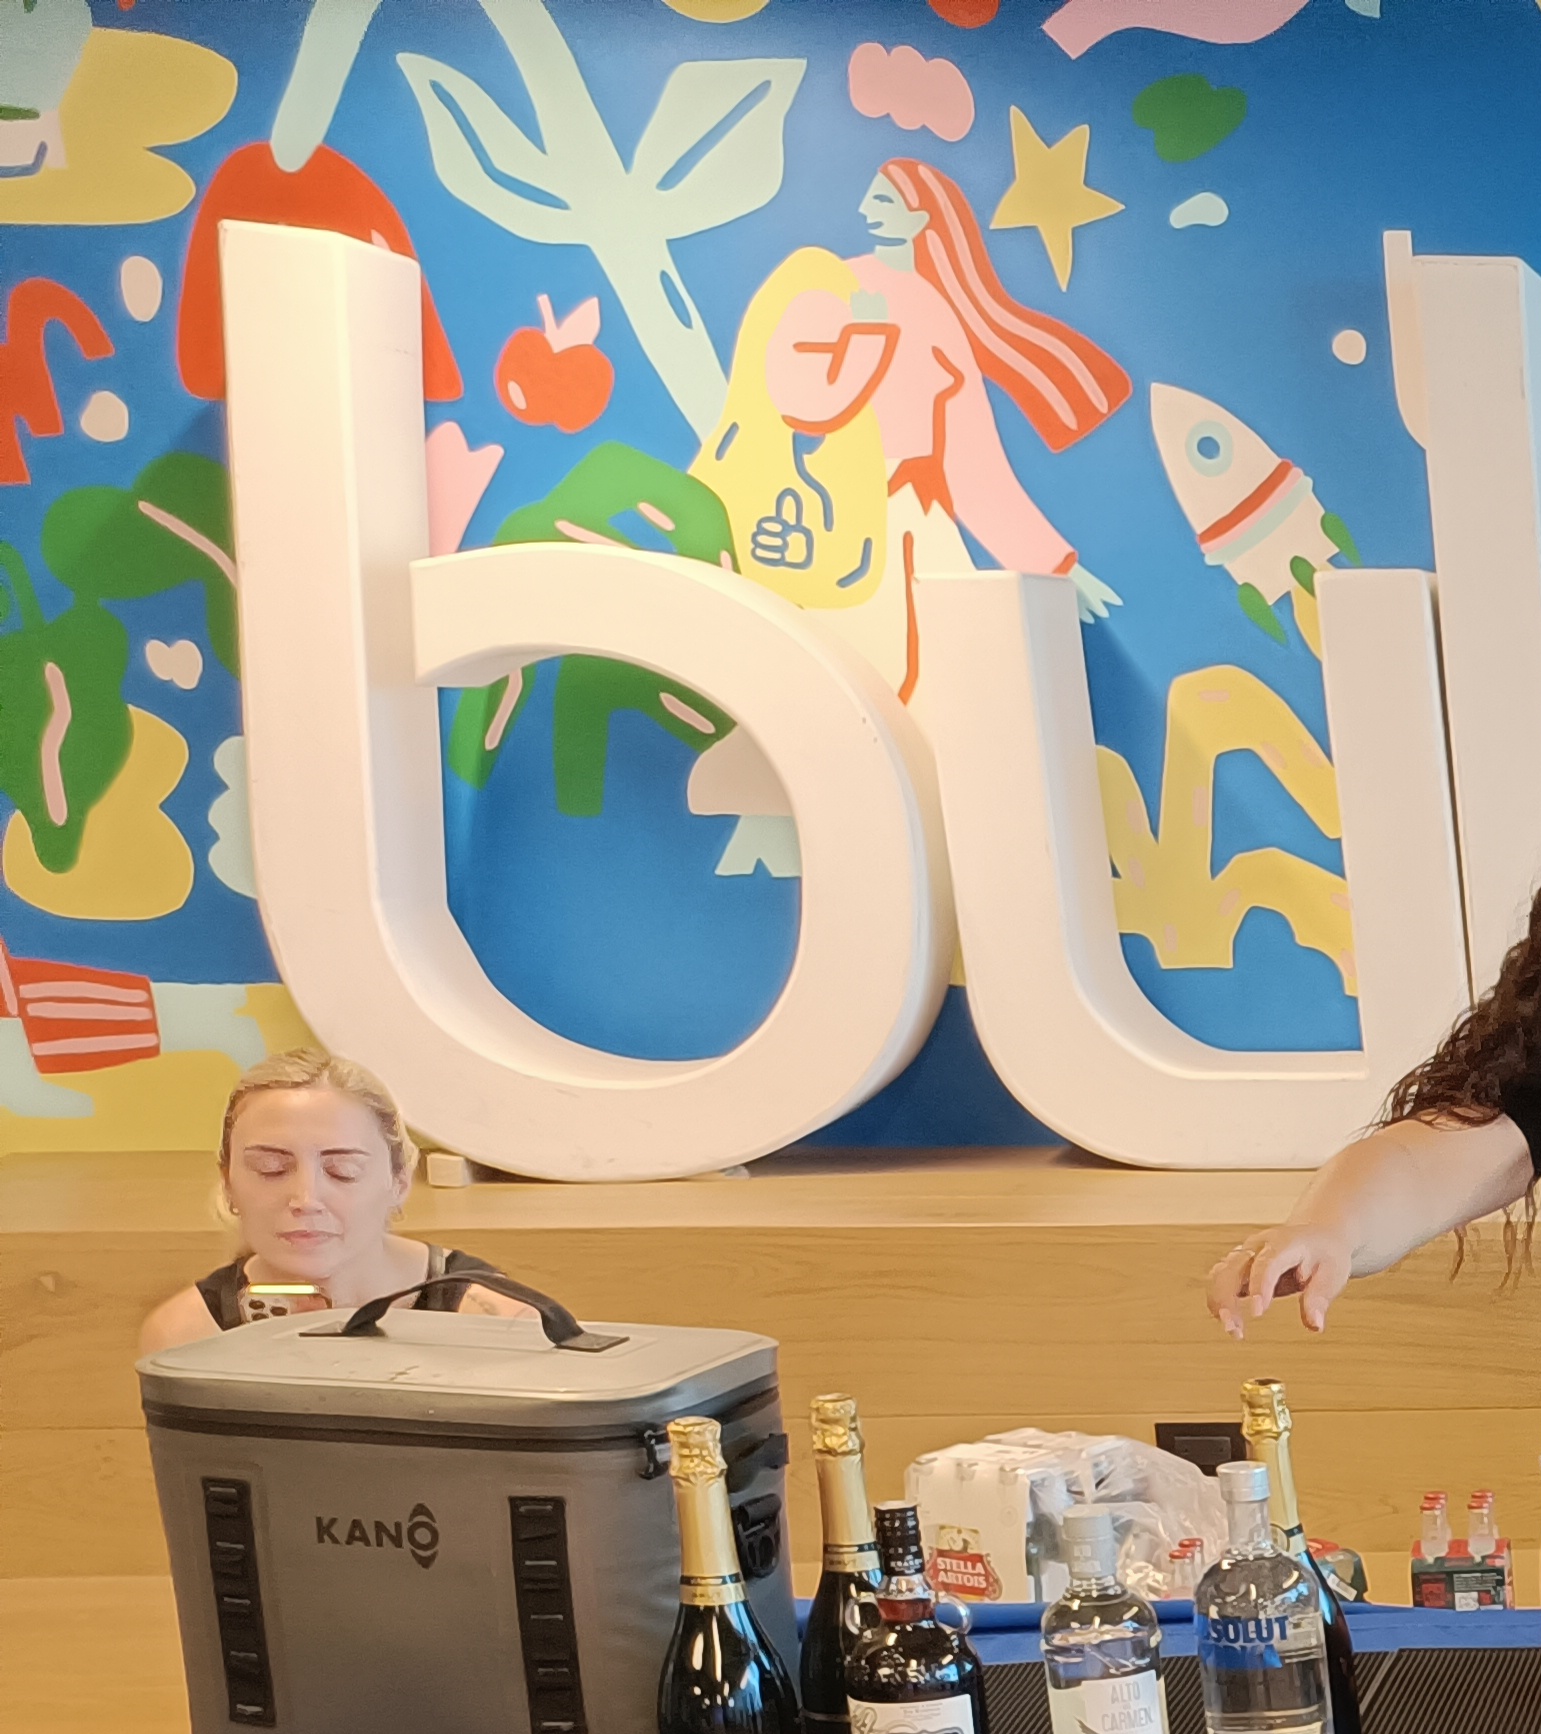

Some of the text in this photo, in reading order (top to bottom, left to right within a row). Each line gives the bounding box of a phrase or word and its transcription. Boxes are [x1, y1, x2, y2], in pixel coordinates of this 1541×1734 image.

[937, 1557, 986, 1575] STELLA
[938, 1570, 987, 1589] ARTOIS
[1205, 1616, 1290, 1644] SOLUT
[1111, 1680, 1141, 1704] ALTO
[1101, 1706, 1154, 1732] CARMEN
